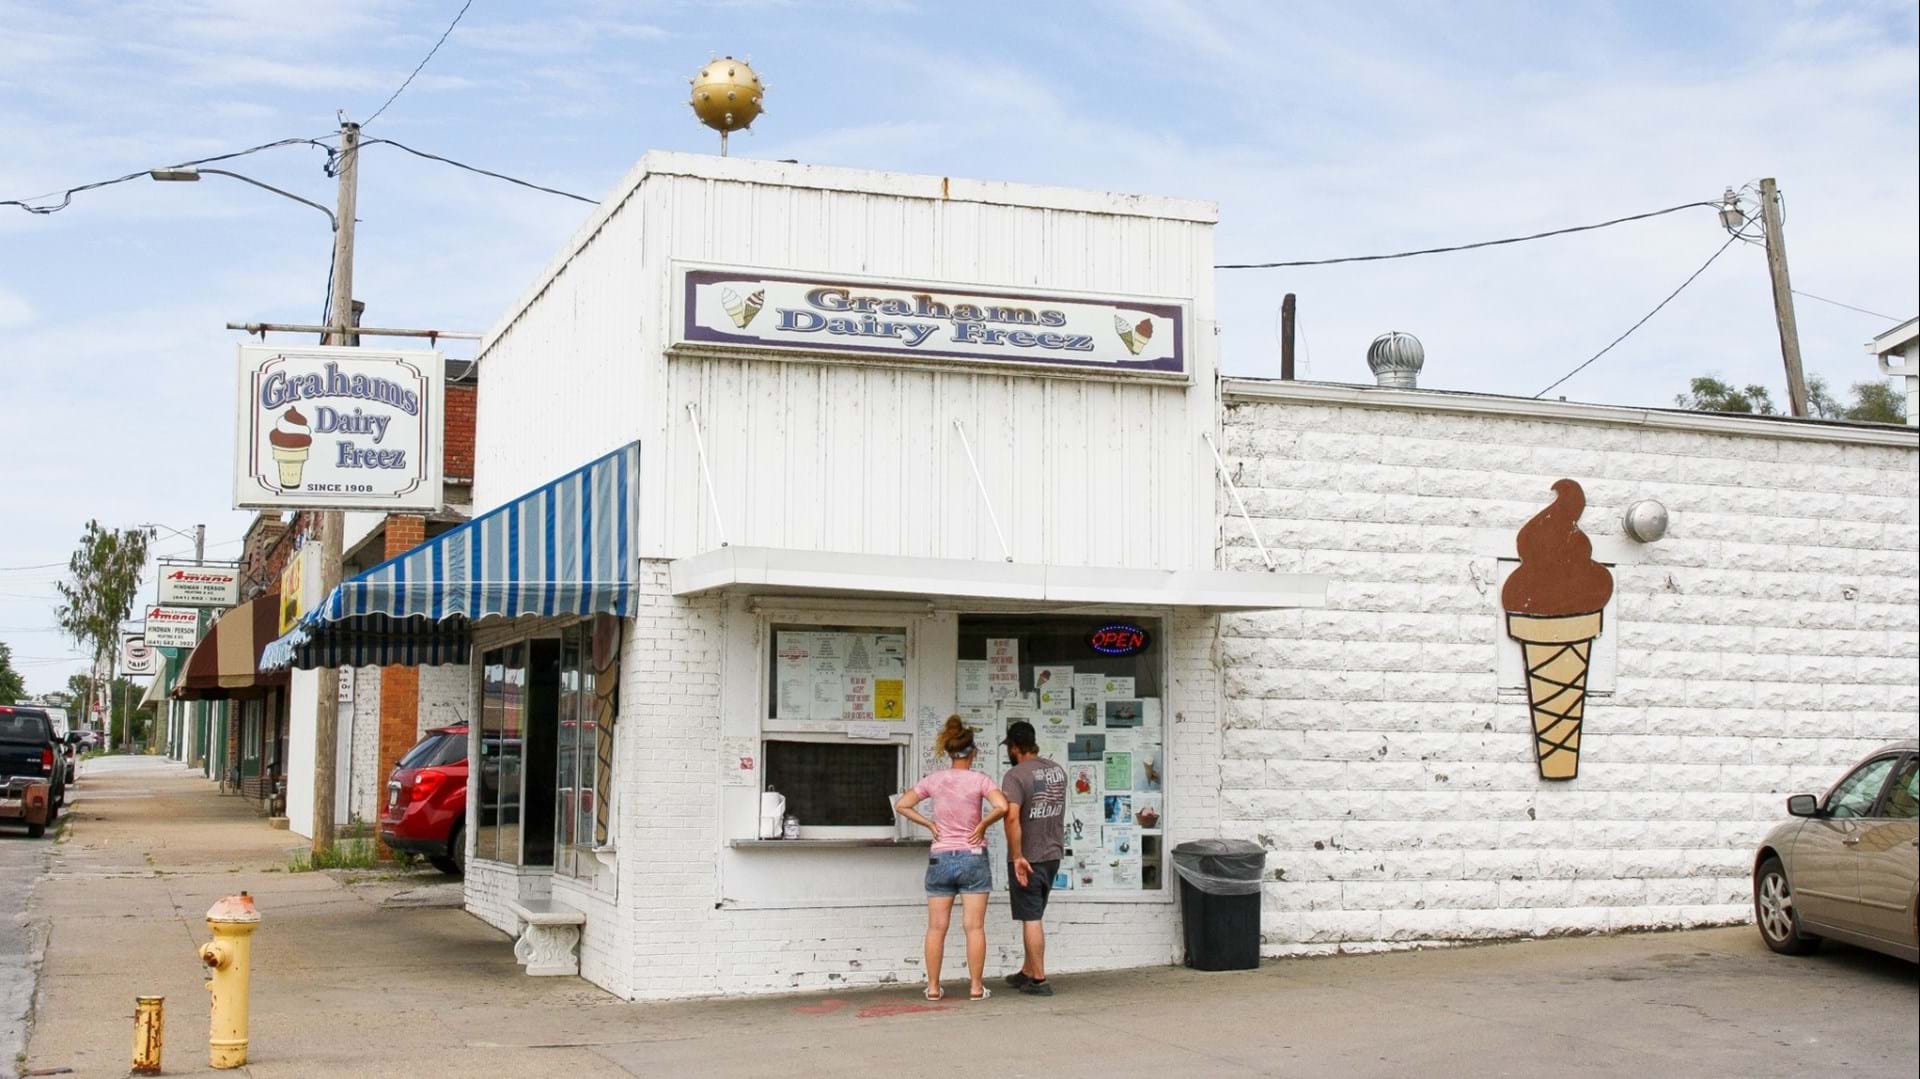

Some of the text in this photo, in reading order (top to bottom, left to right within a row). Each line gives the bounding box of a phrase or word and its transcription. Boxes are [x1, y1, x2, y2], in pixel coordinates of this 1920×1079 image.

[804, 287, 1067, 327] Grahams
[776, 308, 1095, 351] Dairy Freez
[261, 361, 418, 416] Grahams
[314, 406, 391, 444] Dairy
[336, 440, 406, 469] Freez
[307, 483, 373, 492] SINCE 1908
[167, 570, 233, 583] Amana
[148, 607, 196, 621] Amana
[1091, 630, 1143, 648] OPEN
[128, 659, 149, 668] PAINT
[1046, 769, 1064, 785] RUN
[1029, 804, 1062, 818] RELOAD
